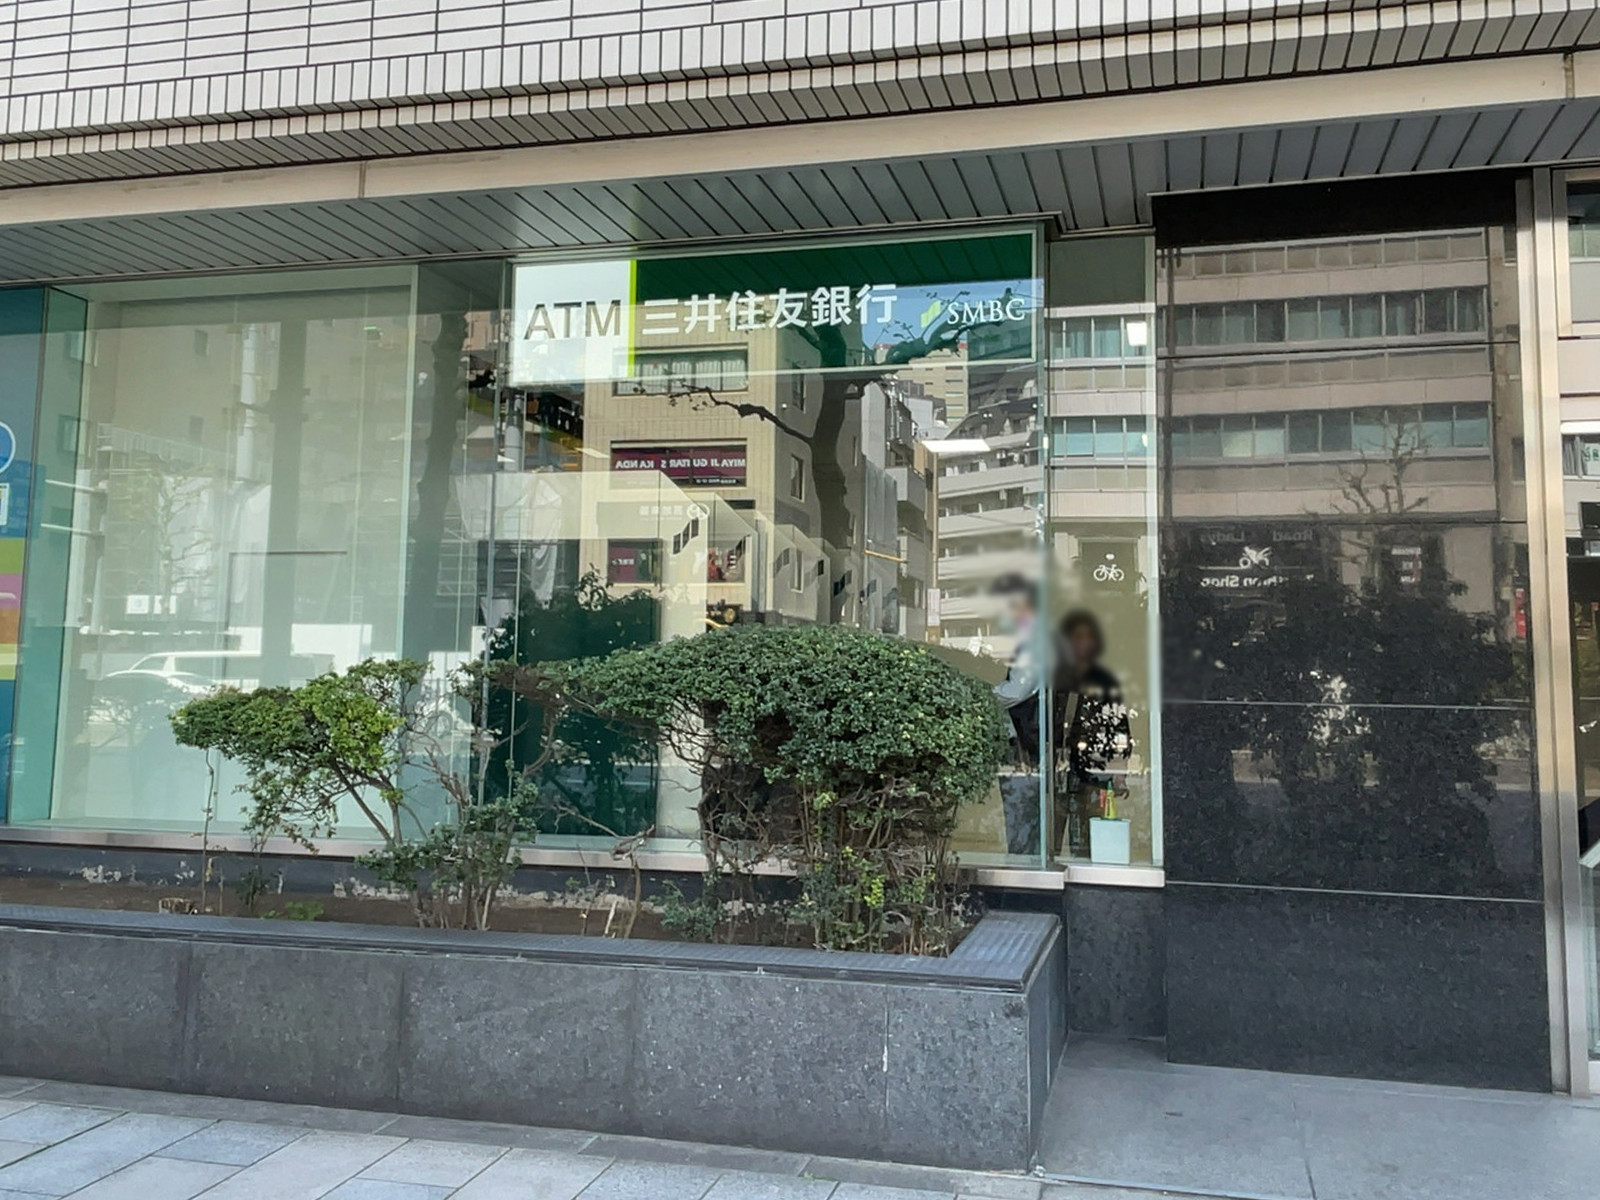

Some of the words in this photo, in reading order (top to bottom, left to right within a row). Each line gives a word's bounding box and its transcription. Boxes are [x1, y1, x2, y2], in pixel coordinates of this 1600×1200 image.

[524, 298, 621, 340] ATM
[641, 284, 897, 336] 三井住友銀行
[947, 296, 1026, 325] SMBC
